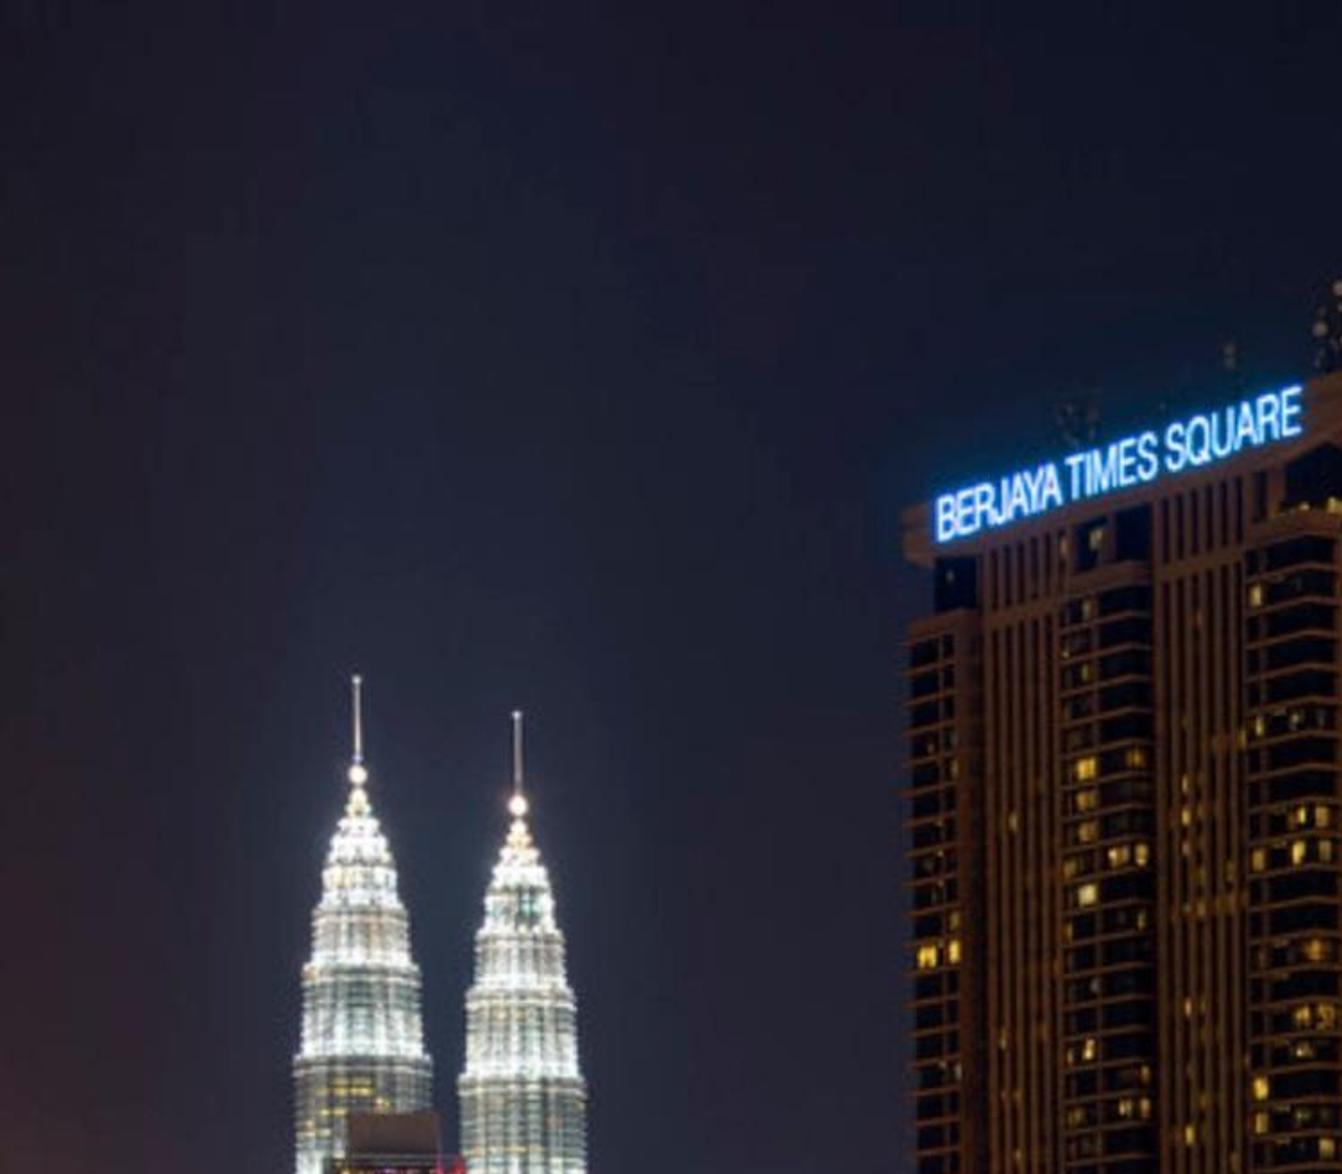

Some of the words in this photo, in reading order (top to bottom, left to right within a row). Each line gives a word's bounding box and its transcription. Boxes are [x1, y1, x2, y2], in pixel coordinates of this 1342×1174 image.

[936, 463, 1063, 542] BERJAYA
[1064, 431, 1159, 500] TIMES
[1163, 384, 1303, 473] SQUARE
